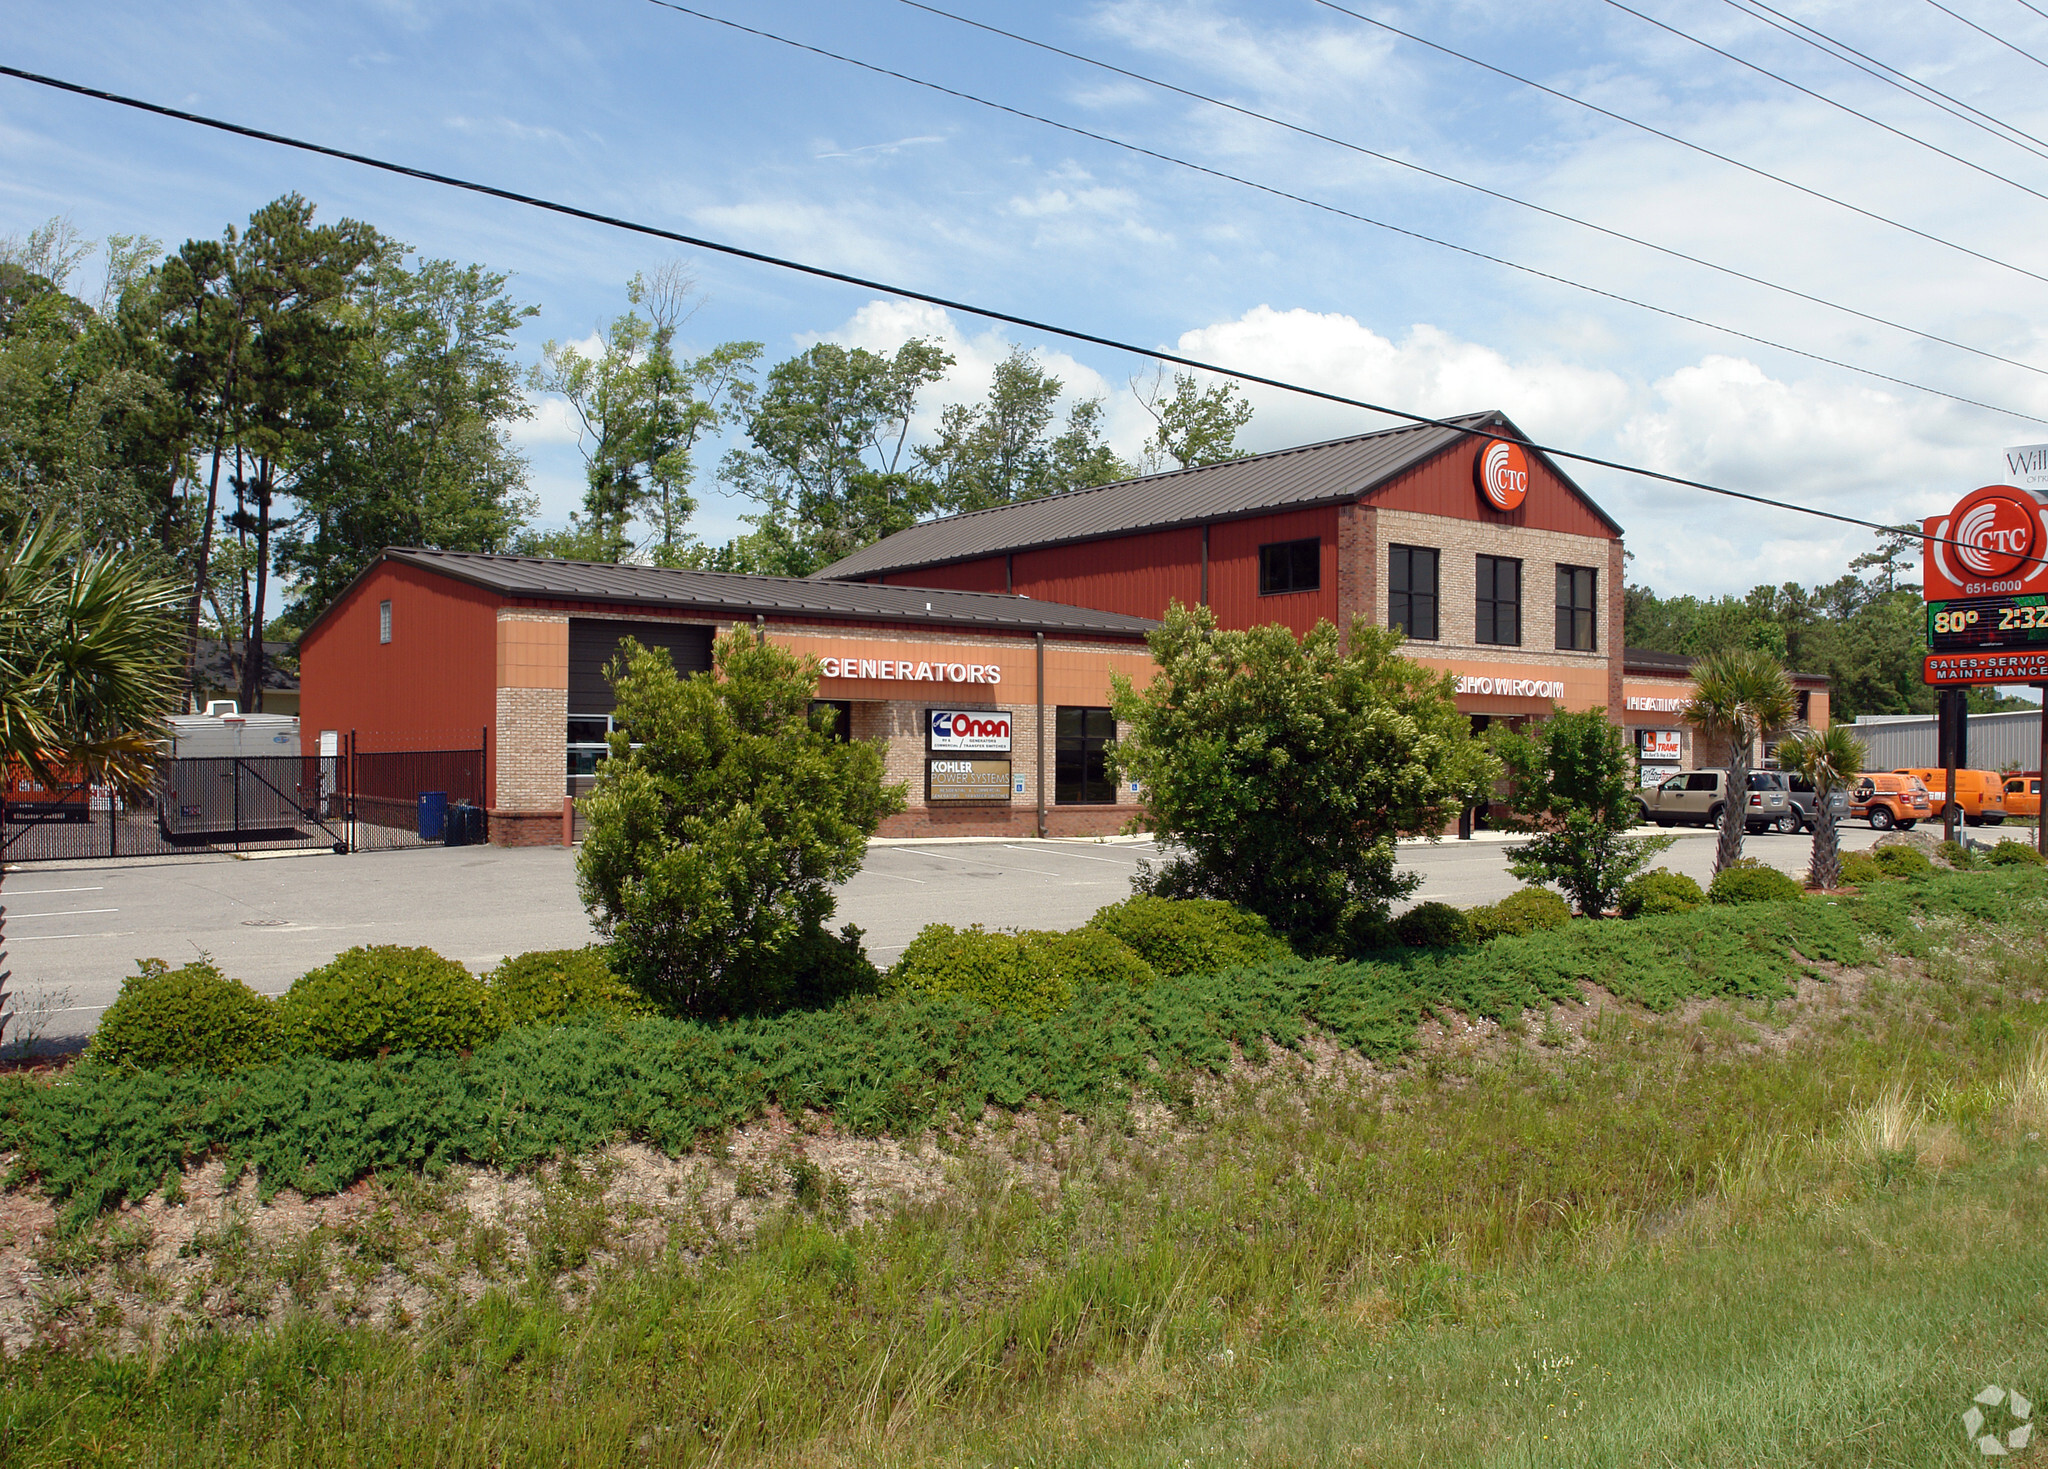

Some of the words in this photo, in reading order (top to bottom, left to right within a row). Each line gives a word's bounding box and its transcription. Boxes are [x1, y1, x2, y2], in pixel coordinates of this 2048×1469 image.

[1498, 468, 1526, 492] CTC
[1977, 528, 2026, 555] CTC
[1966, 580, 2022, 594] 651-6000
[1998, 605, 2048, 630] 2:32
[819, 656, 1001, 684] GENERATORS
[1930, 658, 1978, 669] SALES
[1937, 666, 2048, 679] MAINTENANCE
[1451, 675, 1564, 698] SHOWROOM
[952, 713, 1009, 737] Onan
[1657, 743, 1679, 752] TRANE
[931, 761, 973, 773] KOHLER
[931, 772, 968, 784] POWER
[970, 773, 1010, 784] SYSTEMS
